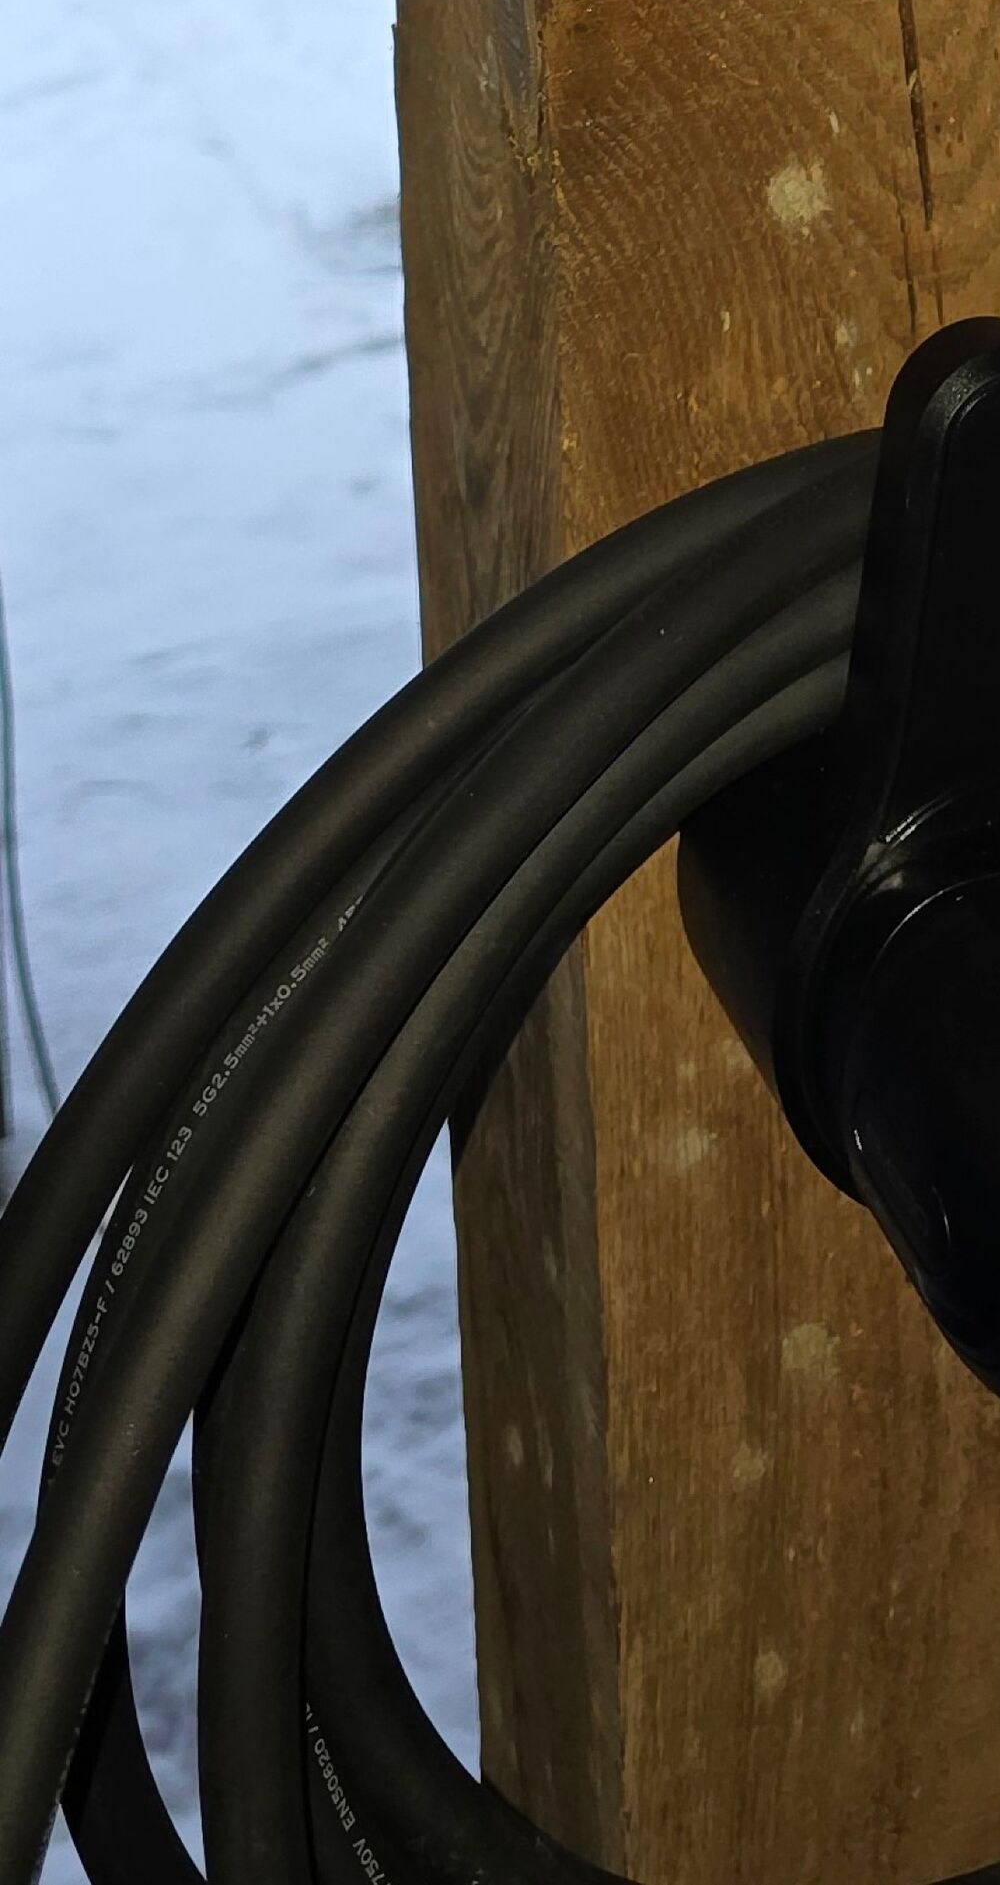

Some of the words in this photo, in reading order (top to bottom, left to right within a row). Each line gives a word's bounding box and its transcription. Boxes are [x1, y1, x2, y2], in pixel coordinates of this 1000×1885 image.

[111, 1208, 149, 1277] 62893
[144, 1165, 170, 1205] IEC
[166, 1125, 193, 1161] 123
